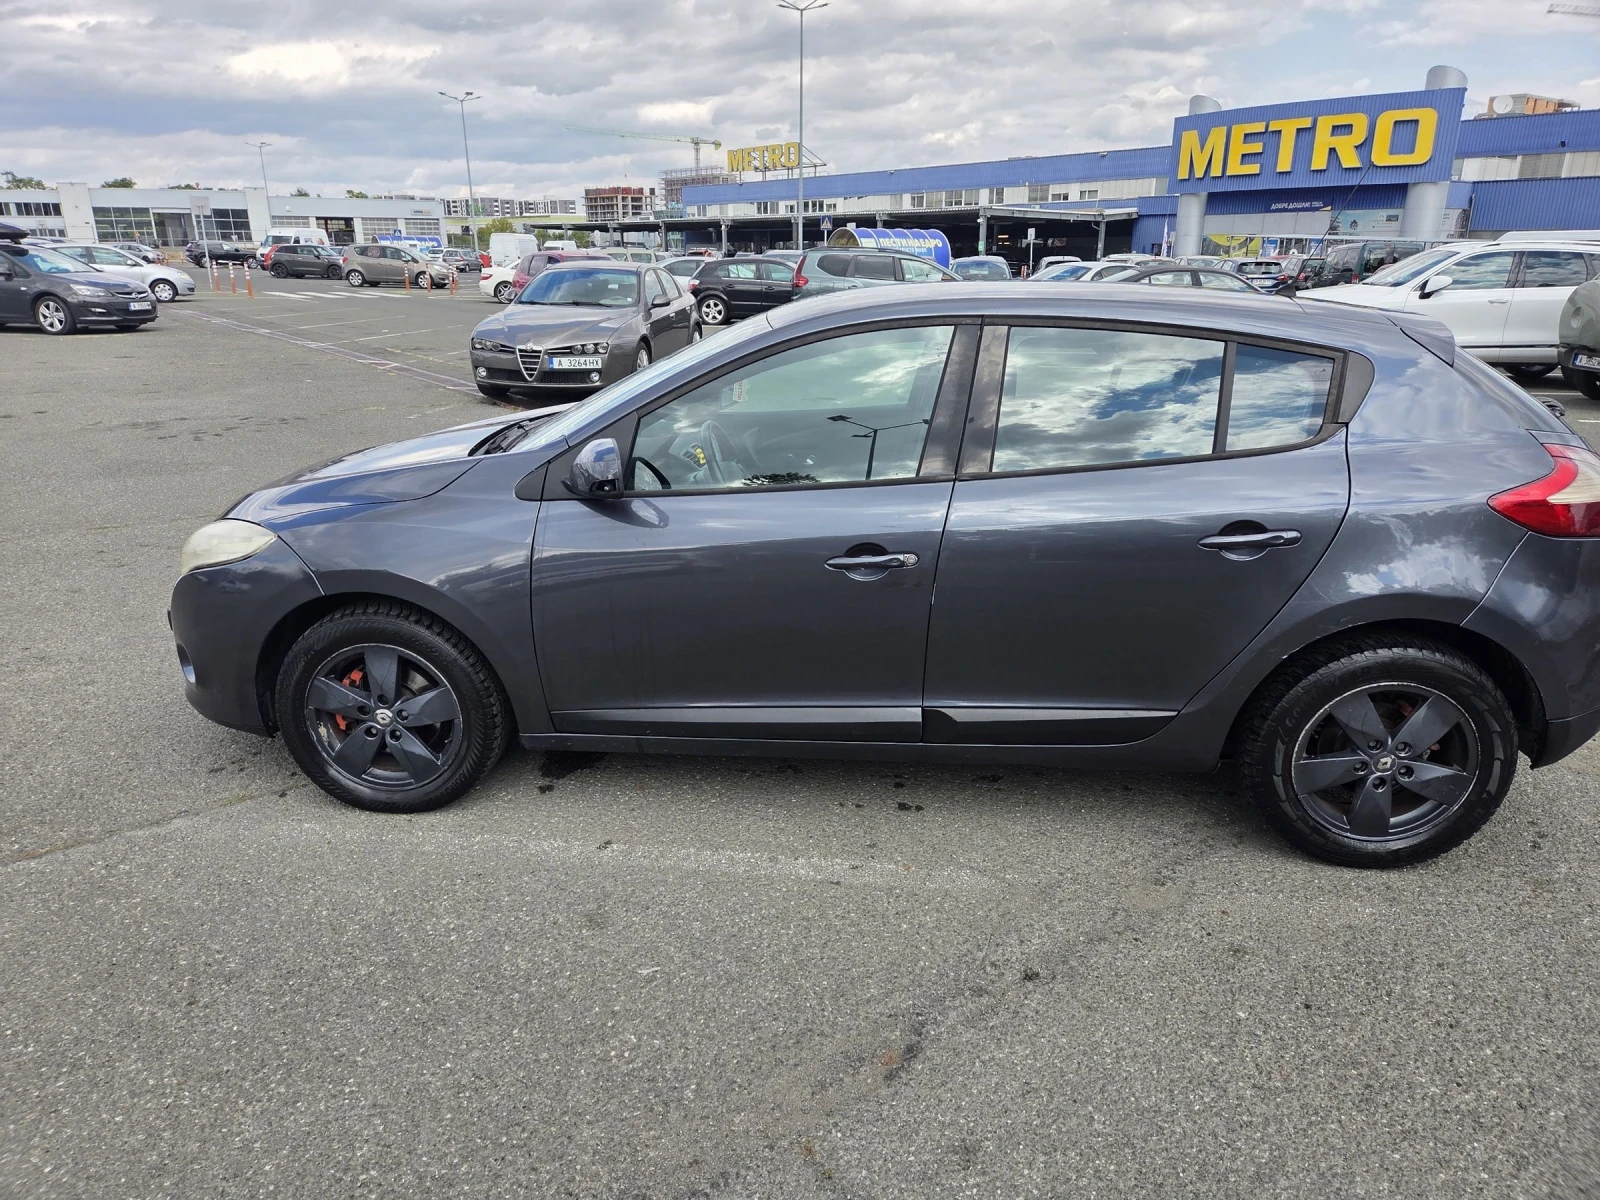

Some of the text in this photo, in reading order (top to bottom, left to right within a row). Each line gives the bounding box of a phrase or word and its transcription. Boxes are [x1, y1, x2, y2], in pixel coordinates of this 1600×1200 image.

[1177, 107, 1438, 180] METRO
[727, 141, 799, 173] METRO
[1270, 202, 1289, 210] ДОБРЕ
[557, 359, 600, 367] A 3264HX
